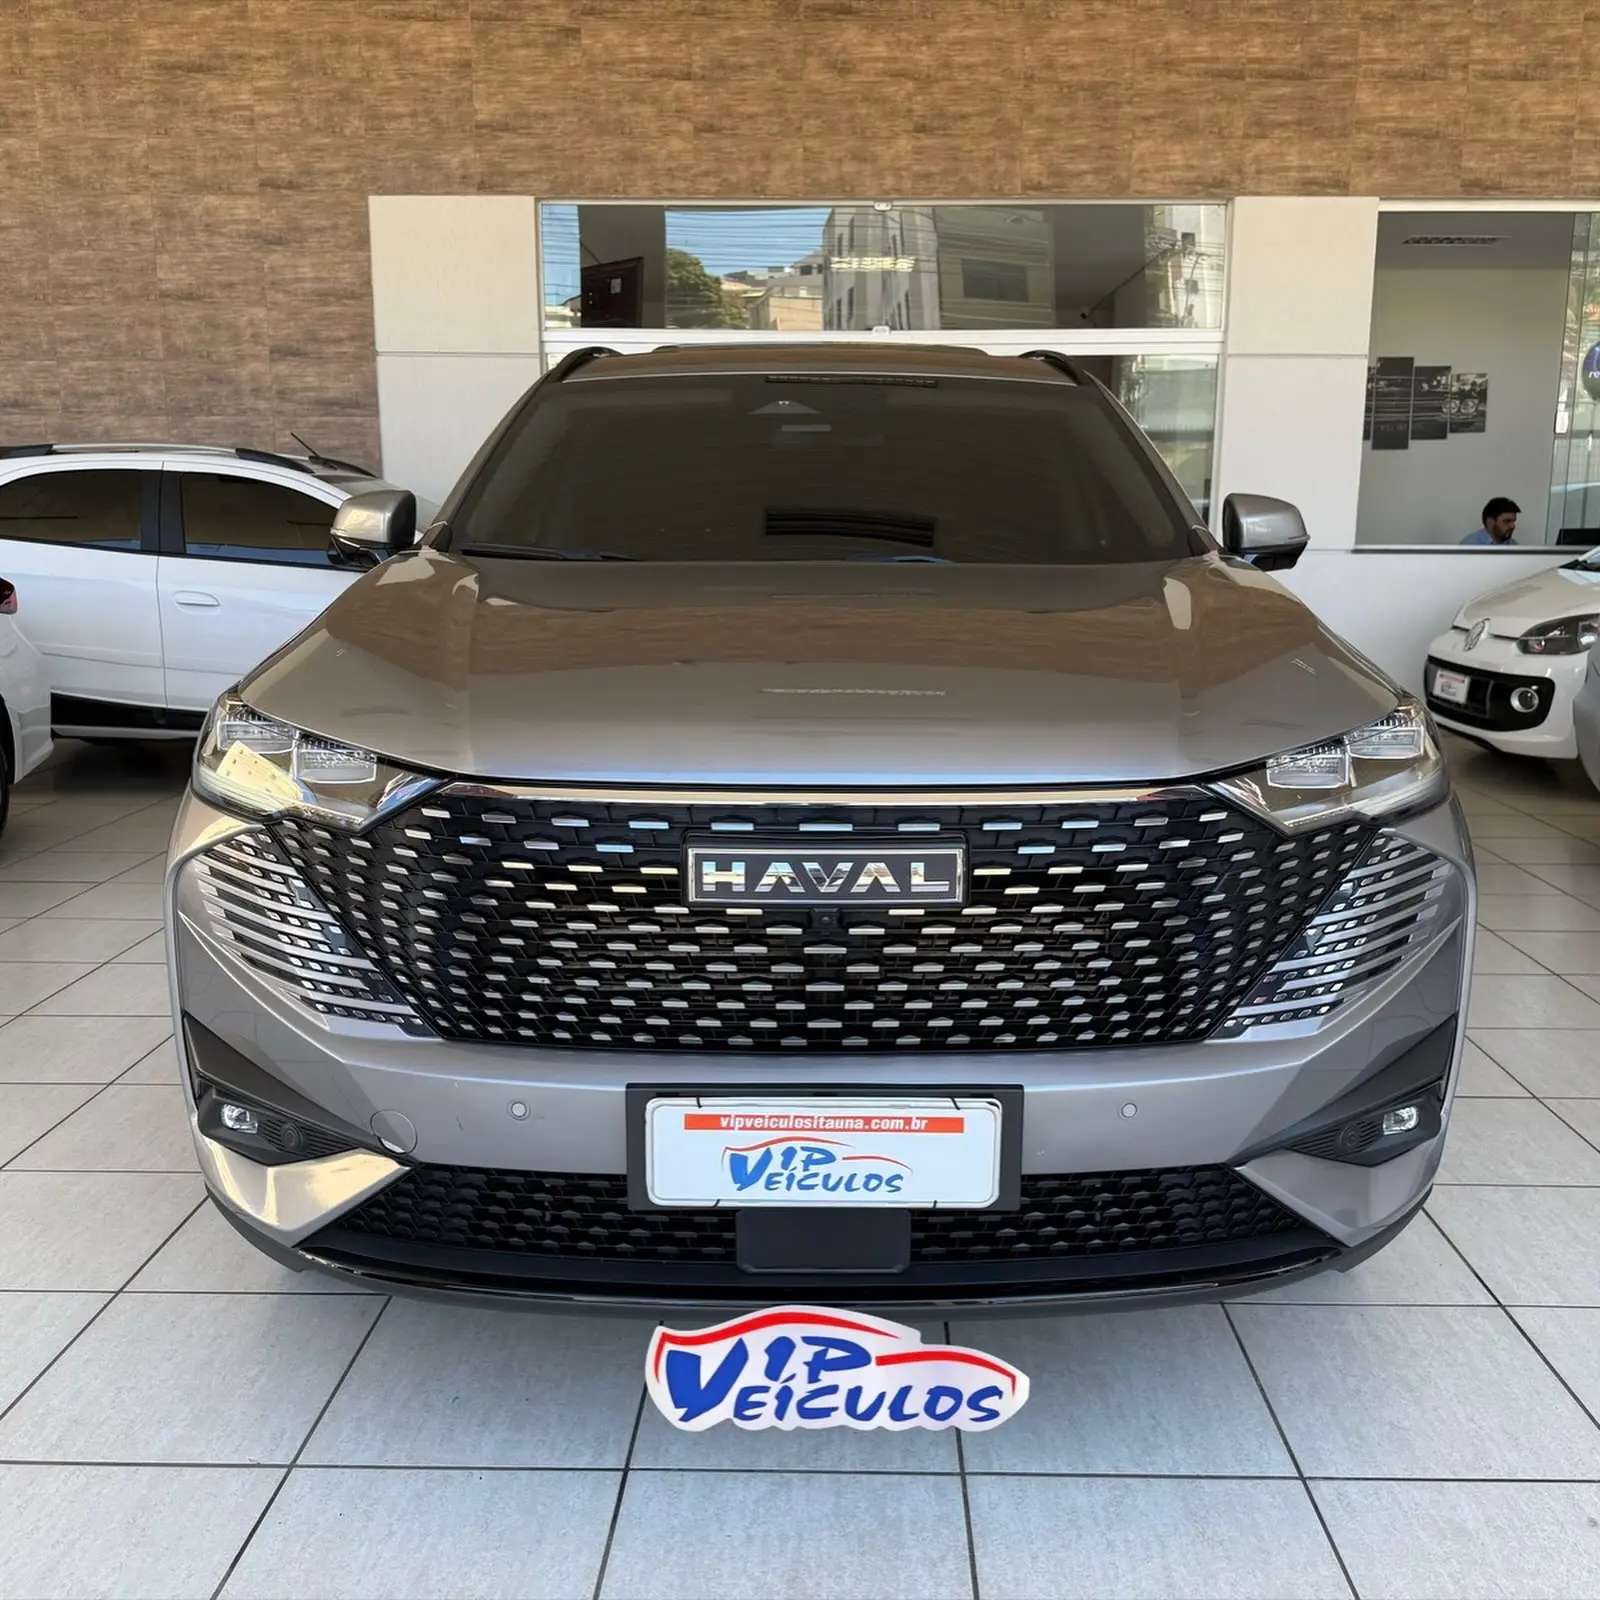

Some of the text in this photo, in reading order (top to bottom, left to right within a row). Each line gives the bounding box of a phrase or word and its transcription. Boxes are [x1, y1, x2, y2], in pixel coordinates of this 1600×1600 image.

[702, 861, 950, 893] HAVAL
[719, 1115, 928, 1131] vipveiculositauna.com.br
[727, 1145, 837, 1192] VIP
[665, 1335, 872, 1422] VIP
